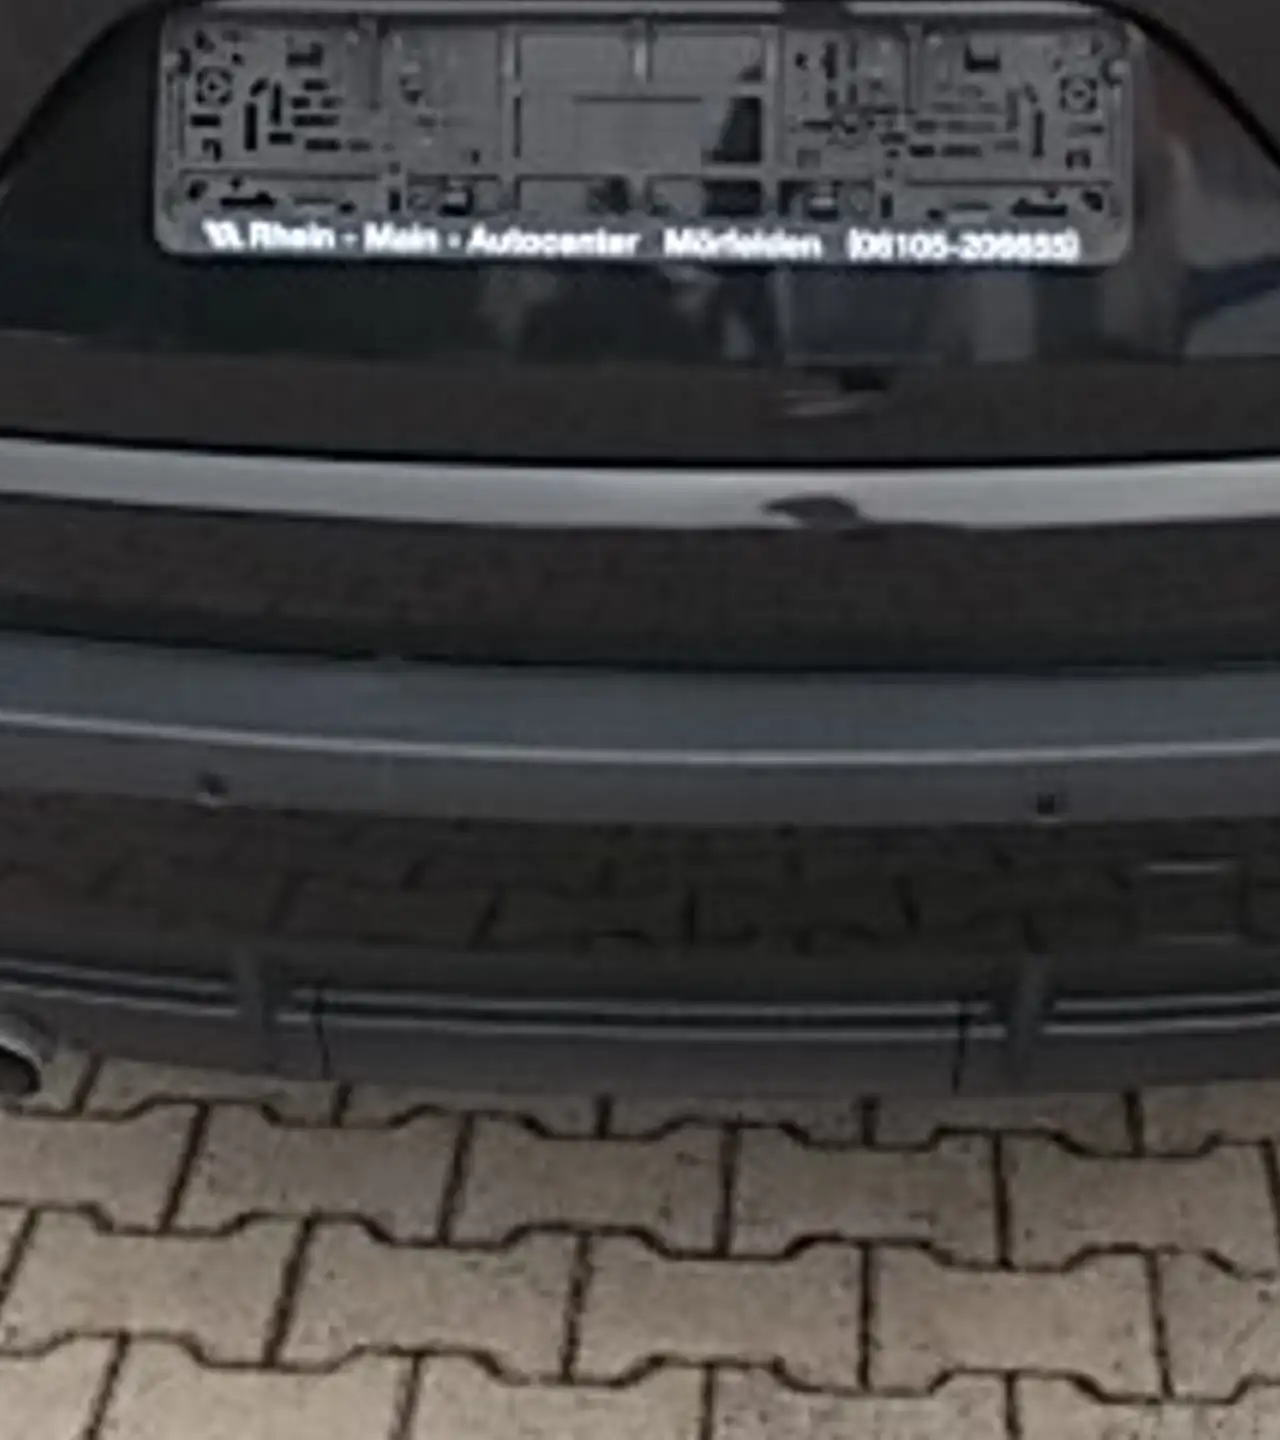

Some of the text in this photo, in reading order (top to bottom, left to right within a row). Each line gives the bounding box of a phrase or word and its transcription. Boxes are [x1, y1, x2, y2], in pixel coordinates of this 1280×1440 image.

[249, 222, 336, 251] Rhein
[363, 222, 440, 252] Main
[465, 225, 642, 256] Autocenter
[662, 227, 823, 259] Mörfelden
